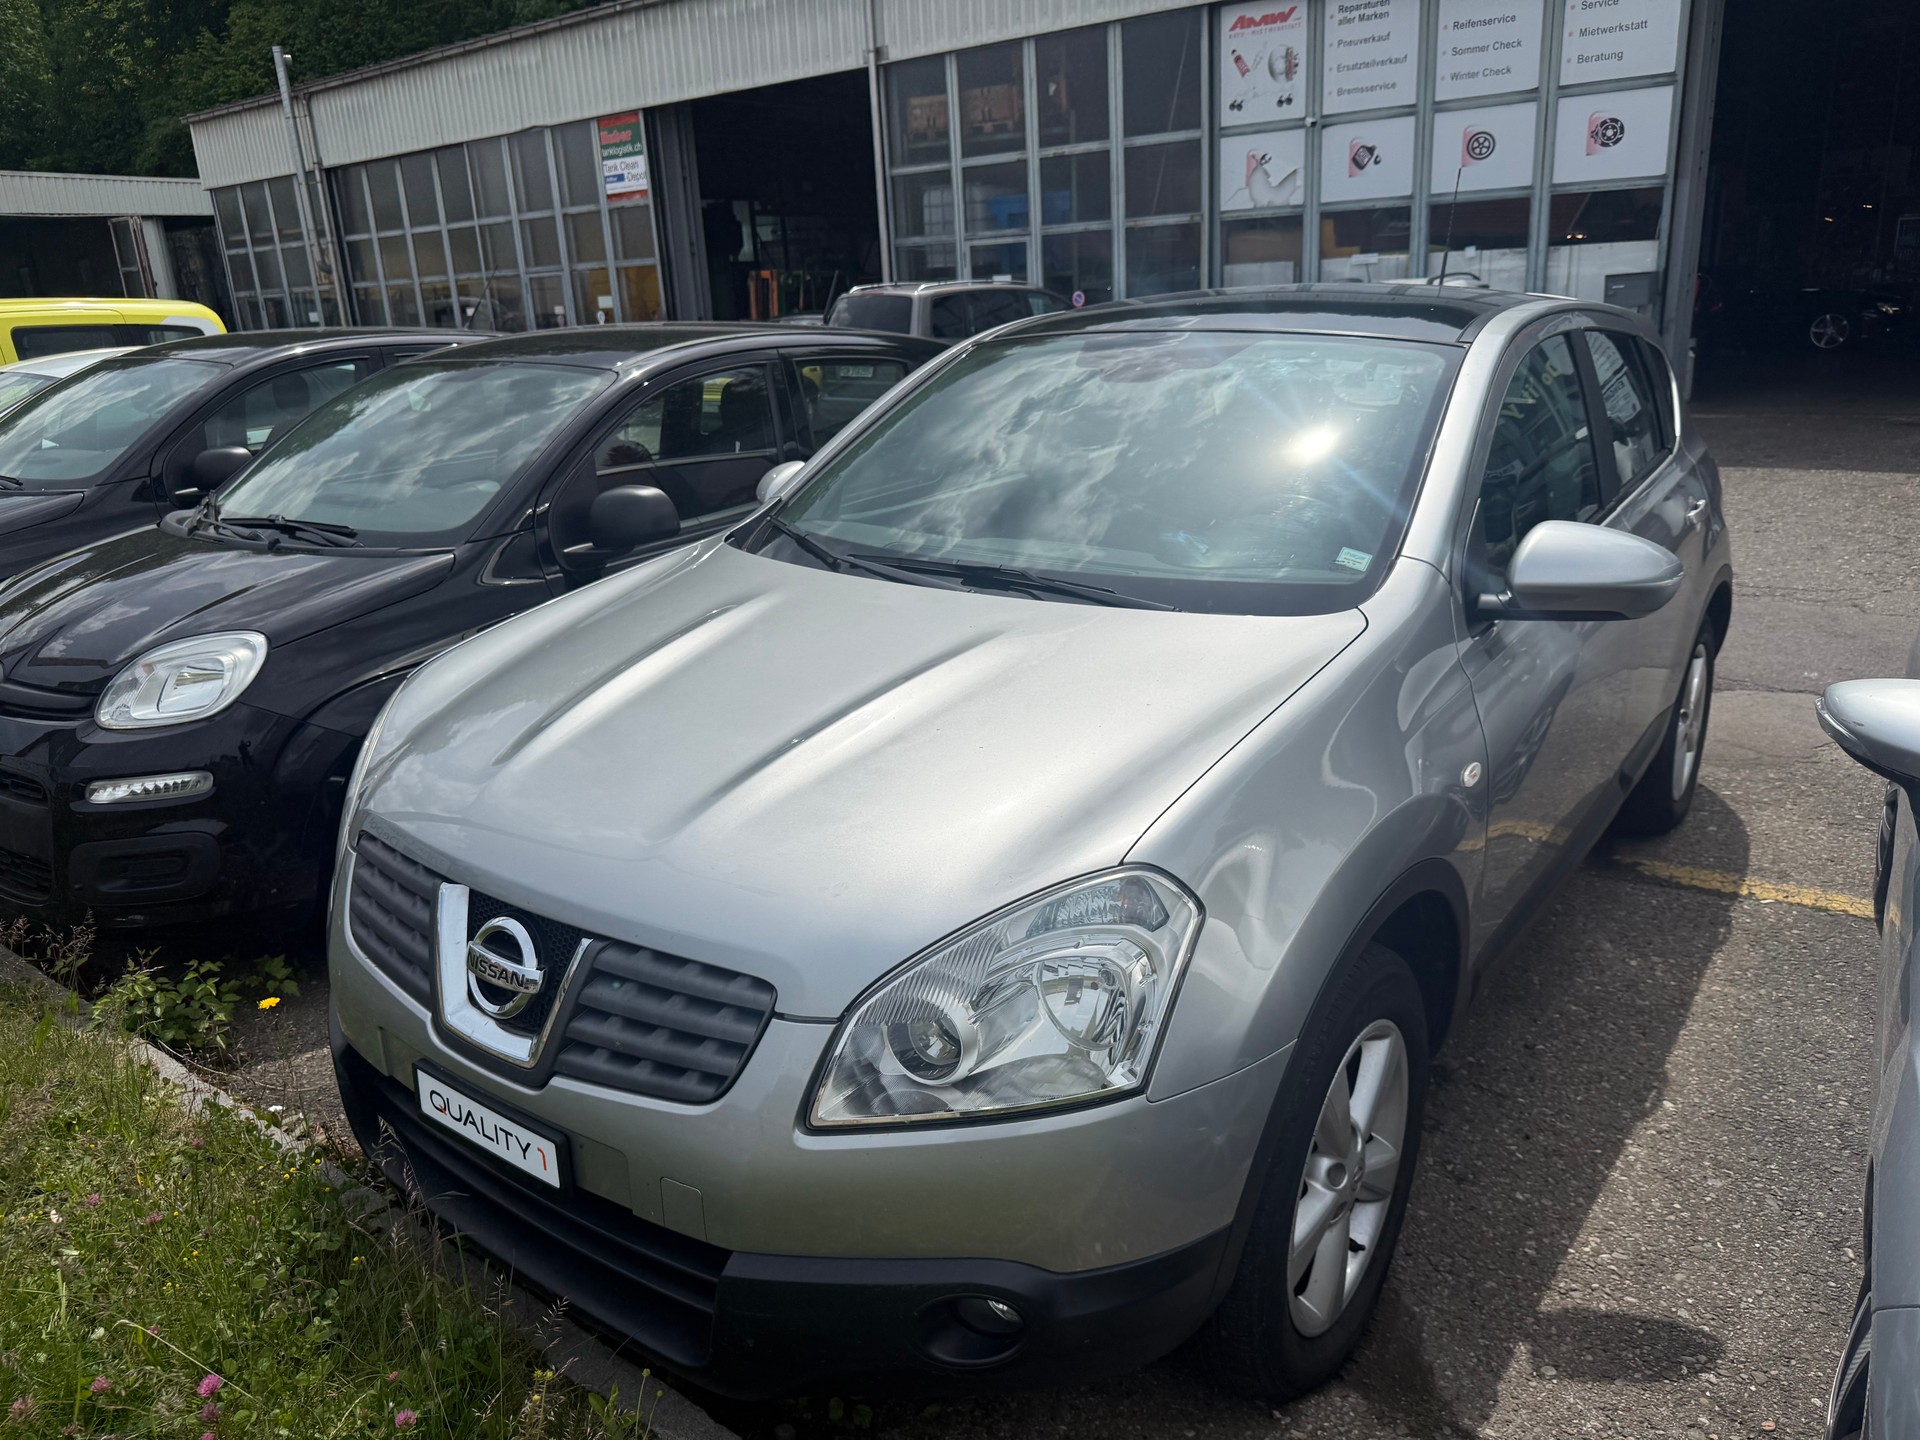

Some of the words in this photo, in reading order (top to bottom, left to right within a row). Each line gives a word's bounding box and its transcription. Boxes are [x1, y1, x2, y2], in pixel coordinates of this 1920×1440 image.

[1338, 0, 1391, 14] Reparaturen
[1229, 5, 1297, 32] AMW
[1338, 16, 1356, 26] aller
[1358, 11, 1390, 22] Marken
[1453, 14, 1516, 30] Reifenservice
[1579, 20, 1648, 37] Mietwerkstatt
[1337, 31, 1391, 48] Pneuverkauf
[1451, 43, 1490, 56] Sommer
[1492, 38, 1522, 51] Check
[1336, 54, 1408, 73] Ersatzteilverkauf
[1577, 51, 1624, 64] Beratung
[1450, 70, 1480, 81] Winter
[1482, 65, 1512, 77] Check
[1336, 81, 1397, 96] Bremsservice
[604, 163, 619, 173] Tank
[620, 161, 640, 172] Clean
[468, 951, 526, 988] NISSAN
